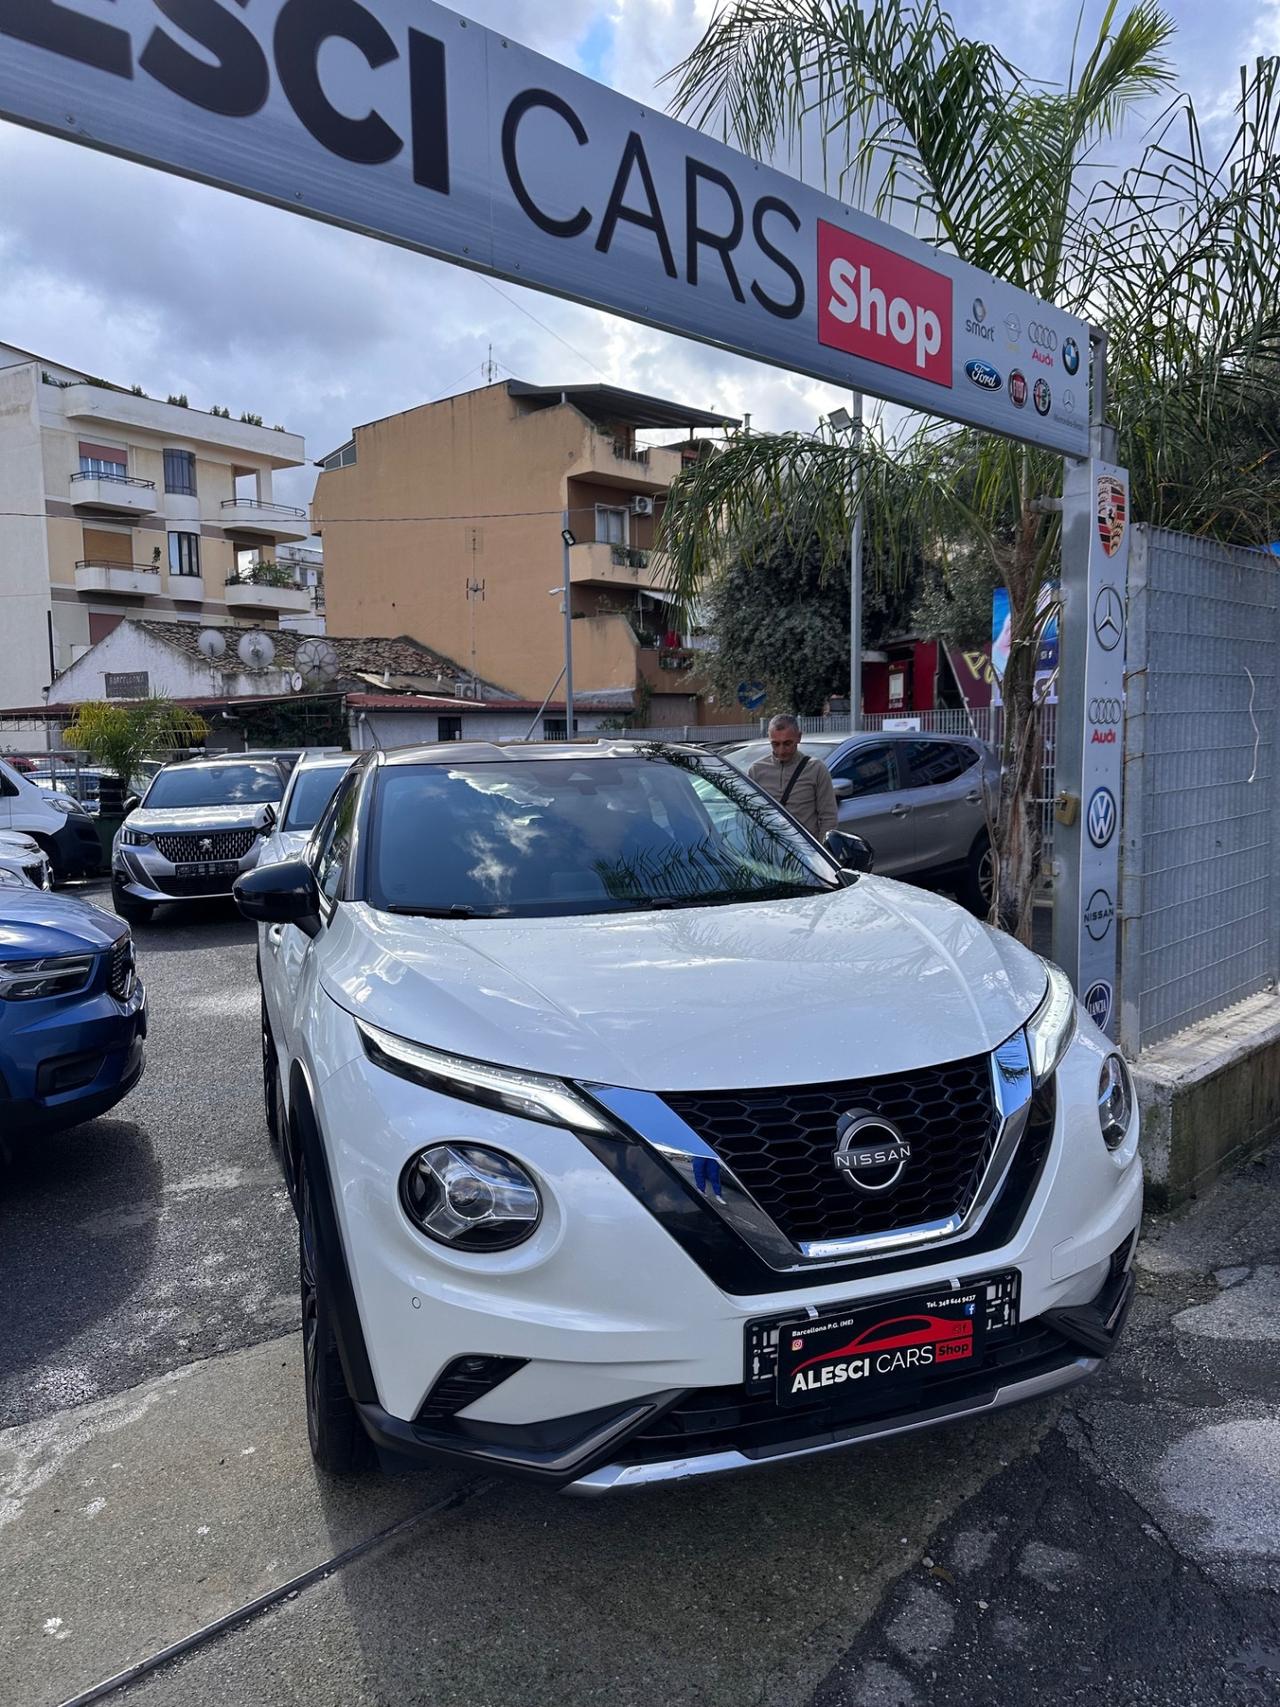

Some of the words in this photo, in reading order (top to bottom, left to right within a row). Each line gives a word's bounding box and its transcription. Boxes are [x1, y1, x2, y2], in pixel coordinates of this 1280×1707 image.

[500, 87, 806, 320] CARS
[827, 256, 942, 368] Shop
[965, 320, 995, 342] smart
[1032, 349, 1054, 367] Audi
[971, 363, 996, 387] Ford
[1091, 729, 1116, 744] Audi
[1083, 908, 1114, 923] NISSAN
[836, 1145, 911, 1167] NISSAN
[792, 1325, 827, 1337] Barcellona
[791, 1358, 870, 1393] ALESCI
[876, 1346, 934, 1373] CARS
[938, 1344, 969, 1356] Shop
